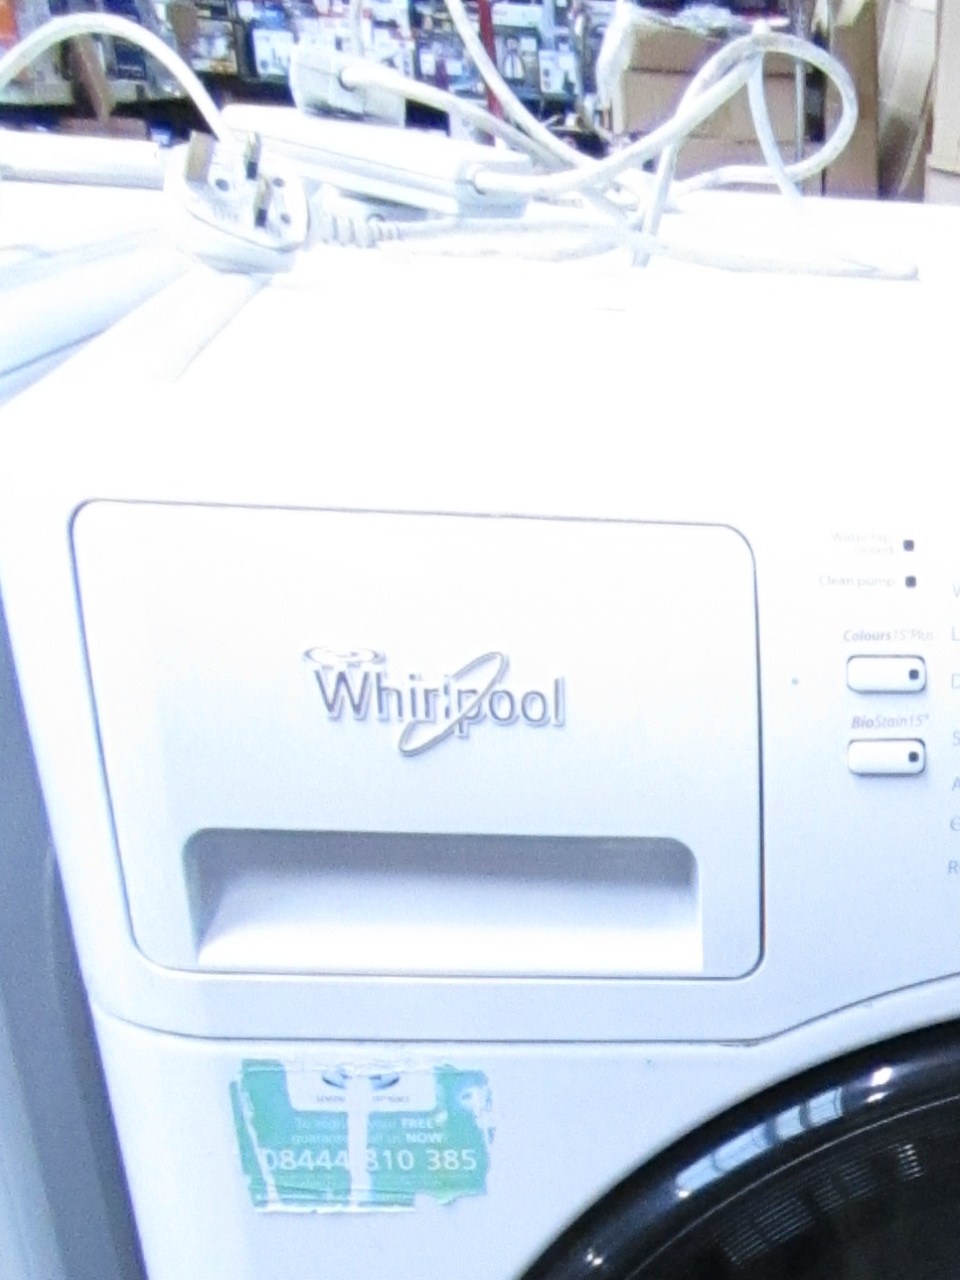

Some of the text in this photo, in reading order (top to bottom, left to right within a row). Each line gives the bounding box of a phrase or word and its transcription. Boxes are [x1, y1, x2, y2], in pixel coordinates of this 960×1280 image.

[818, 575, 896, 589] Clean pump
[308, 656, 566, 752] Whirlpool
[405, 1132, 444, 1145] NOW
[426, 1148, 478, 1171] 385
